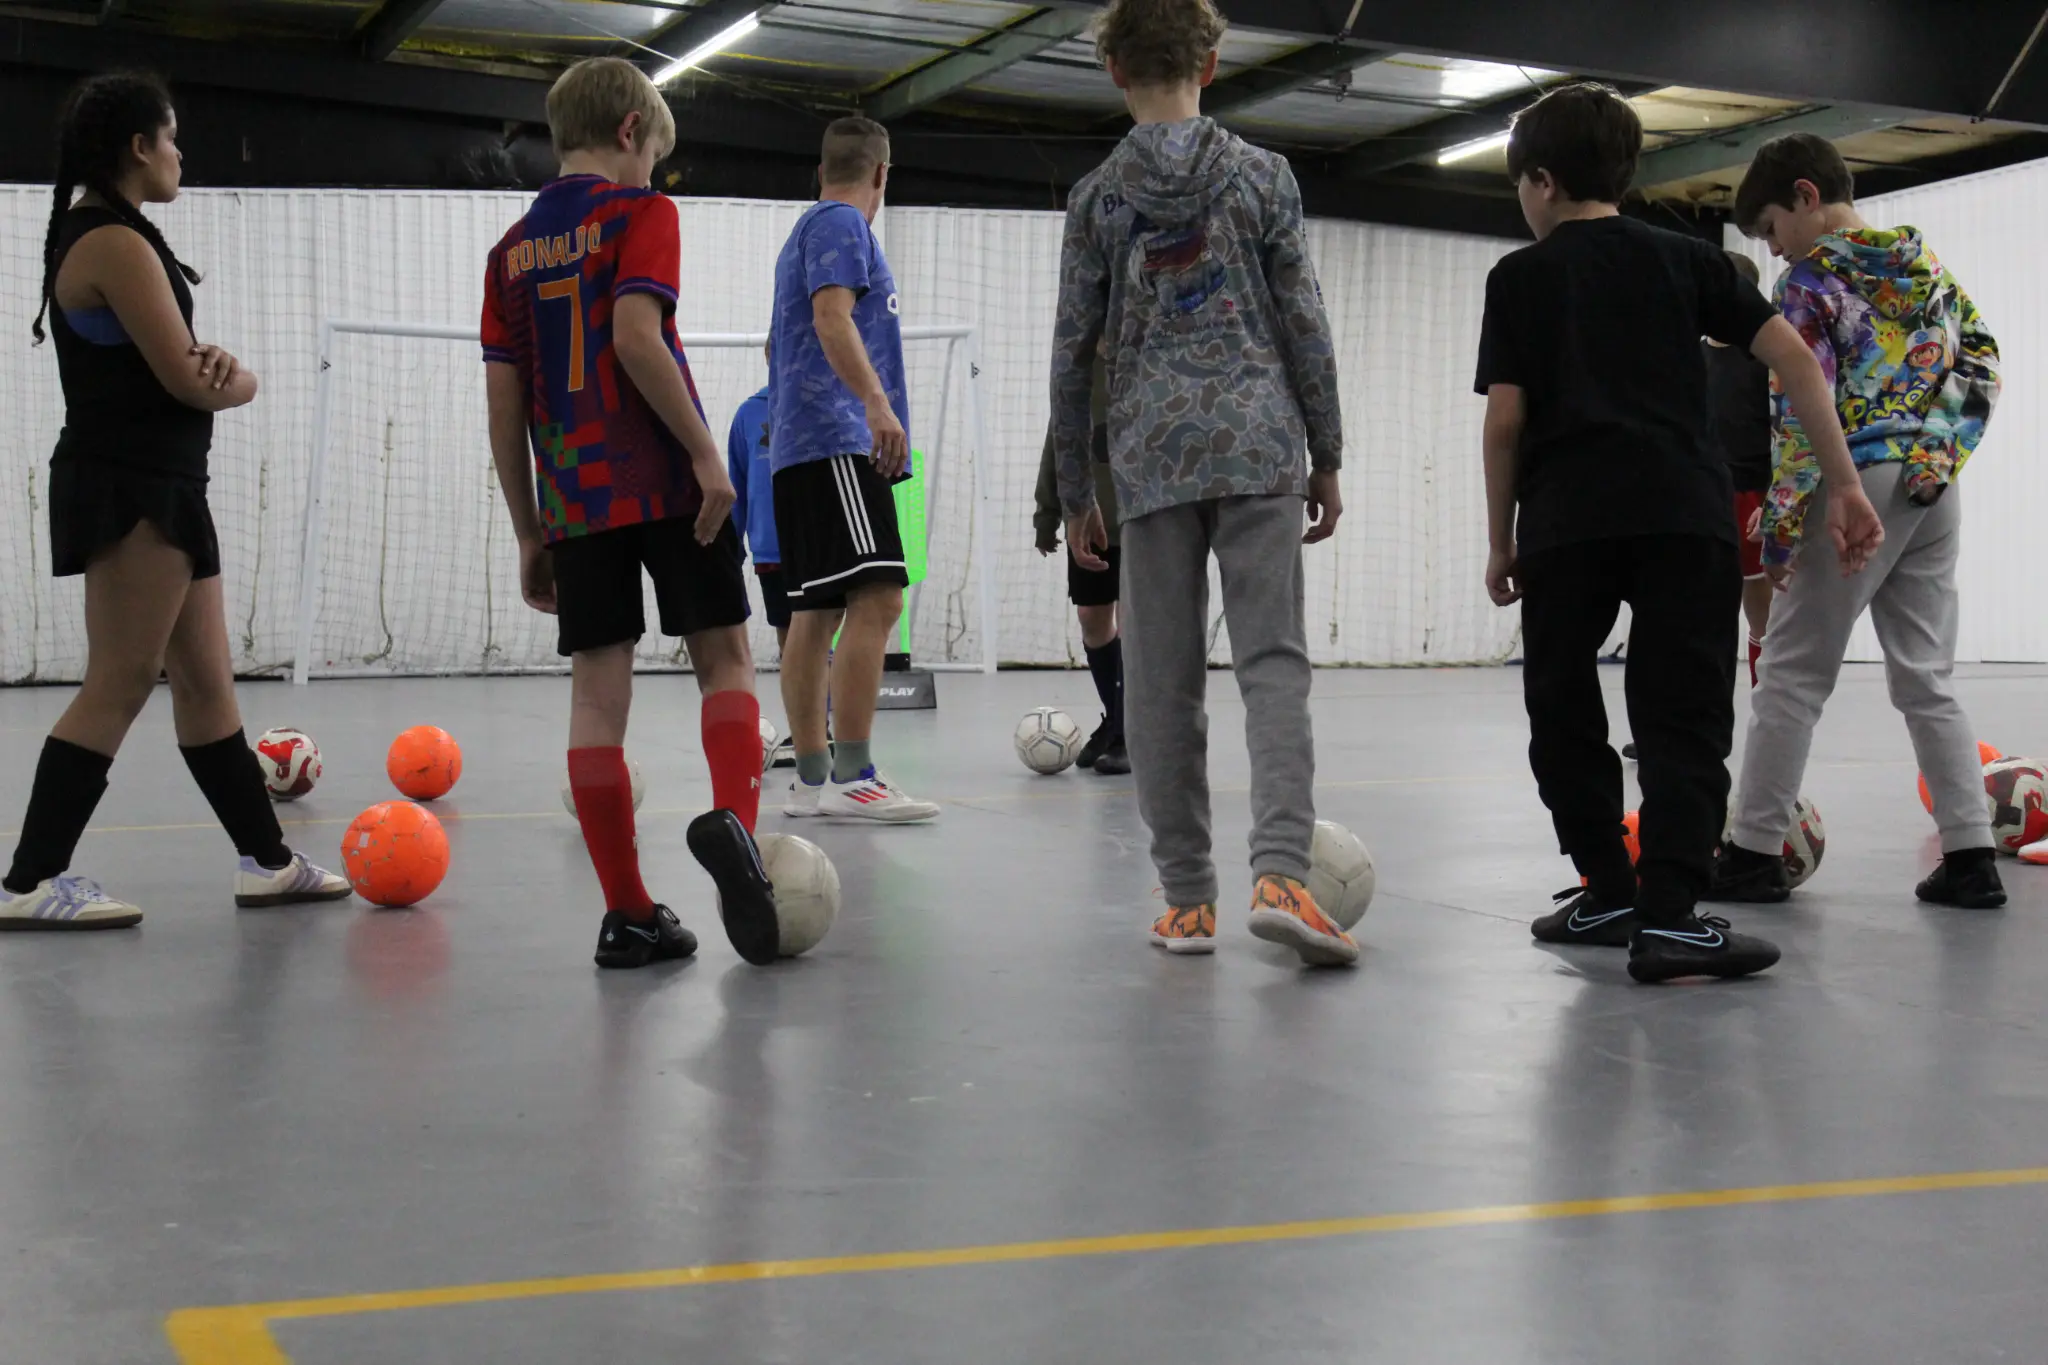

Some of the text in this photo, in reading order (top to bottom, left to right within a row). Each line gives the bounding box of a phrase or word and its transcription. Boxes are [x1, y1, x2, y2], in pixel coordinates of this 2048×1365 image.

[507, 222, 601, 280] RONALDO
[537, 273, 585, 392] 7
[878, 686, 917, 697] PLAY
